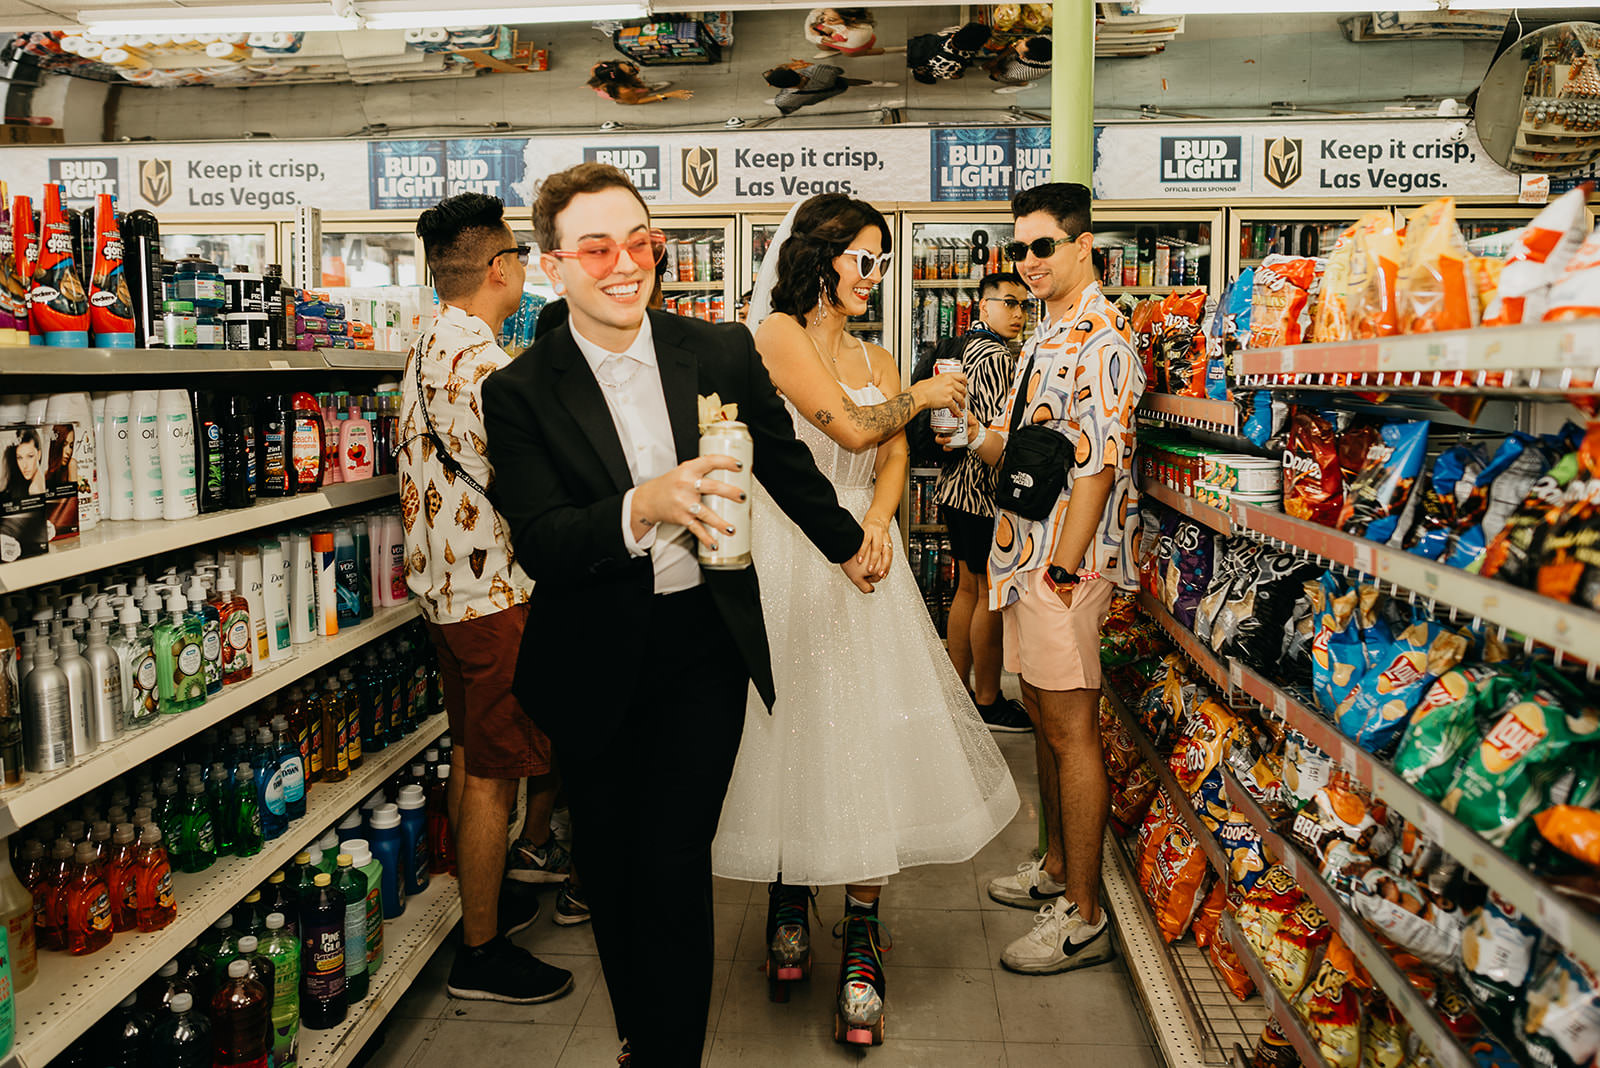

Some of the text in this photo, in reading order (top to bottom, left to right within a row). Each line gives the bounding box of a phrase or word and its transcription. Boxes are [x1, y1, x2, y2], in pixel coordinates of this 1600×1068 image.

[596, 150, 647, 168] BUD
[735, 146, 885, 172] Keep it crisp,
[949, 145, 1004, 165] BUD
[1174, 140, 1228, 159] BUD
[1320, 137, 1476, 164] Keep it crisp,
[60, 161, 107, 180] BUD
[188, 159, 325, 182] Keep it crisp,
[385, 156, 437, 177] BUD
[941, 166, 1013, 187] LIGHT
[1164, 159, 1238, 179] LIGHT.
[53, 179, 116, 198] IGHT
[377, 177, 445, 197] LIGHT
[735, 176, 858, 196] Las Vegas.
[1319, 168, 1448, 192] Las Vegas.
[188, 187, 302, 210] Las Vegas.
[971, 229, 990, 265] 8
[1137, 226, 1158, 262] 9
[1279, 225, 1319, 257] 10
[346, 239, 365, 272] 4
